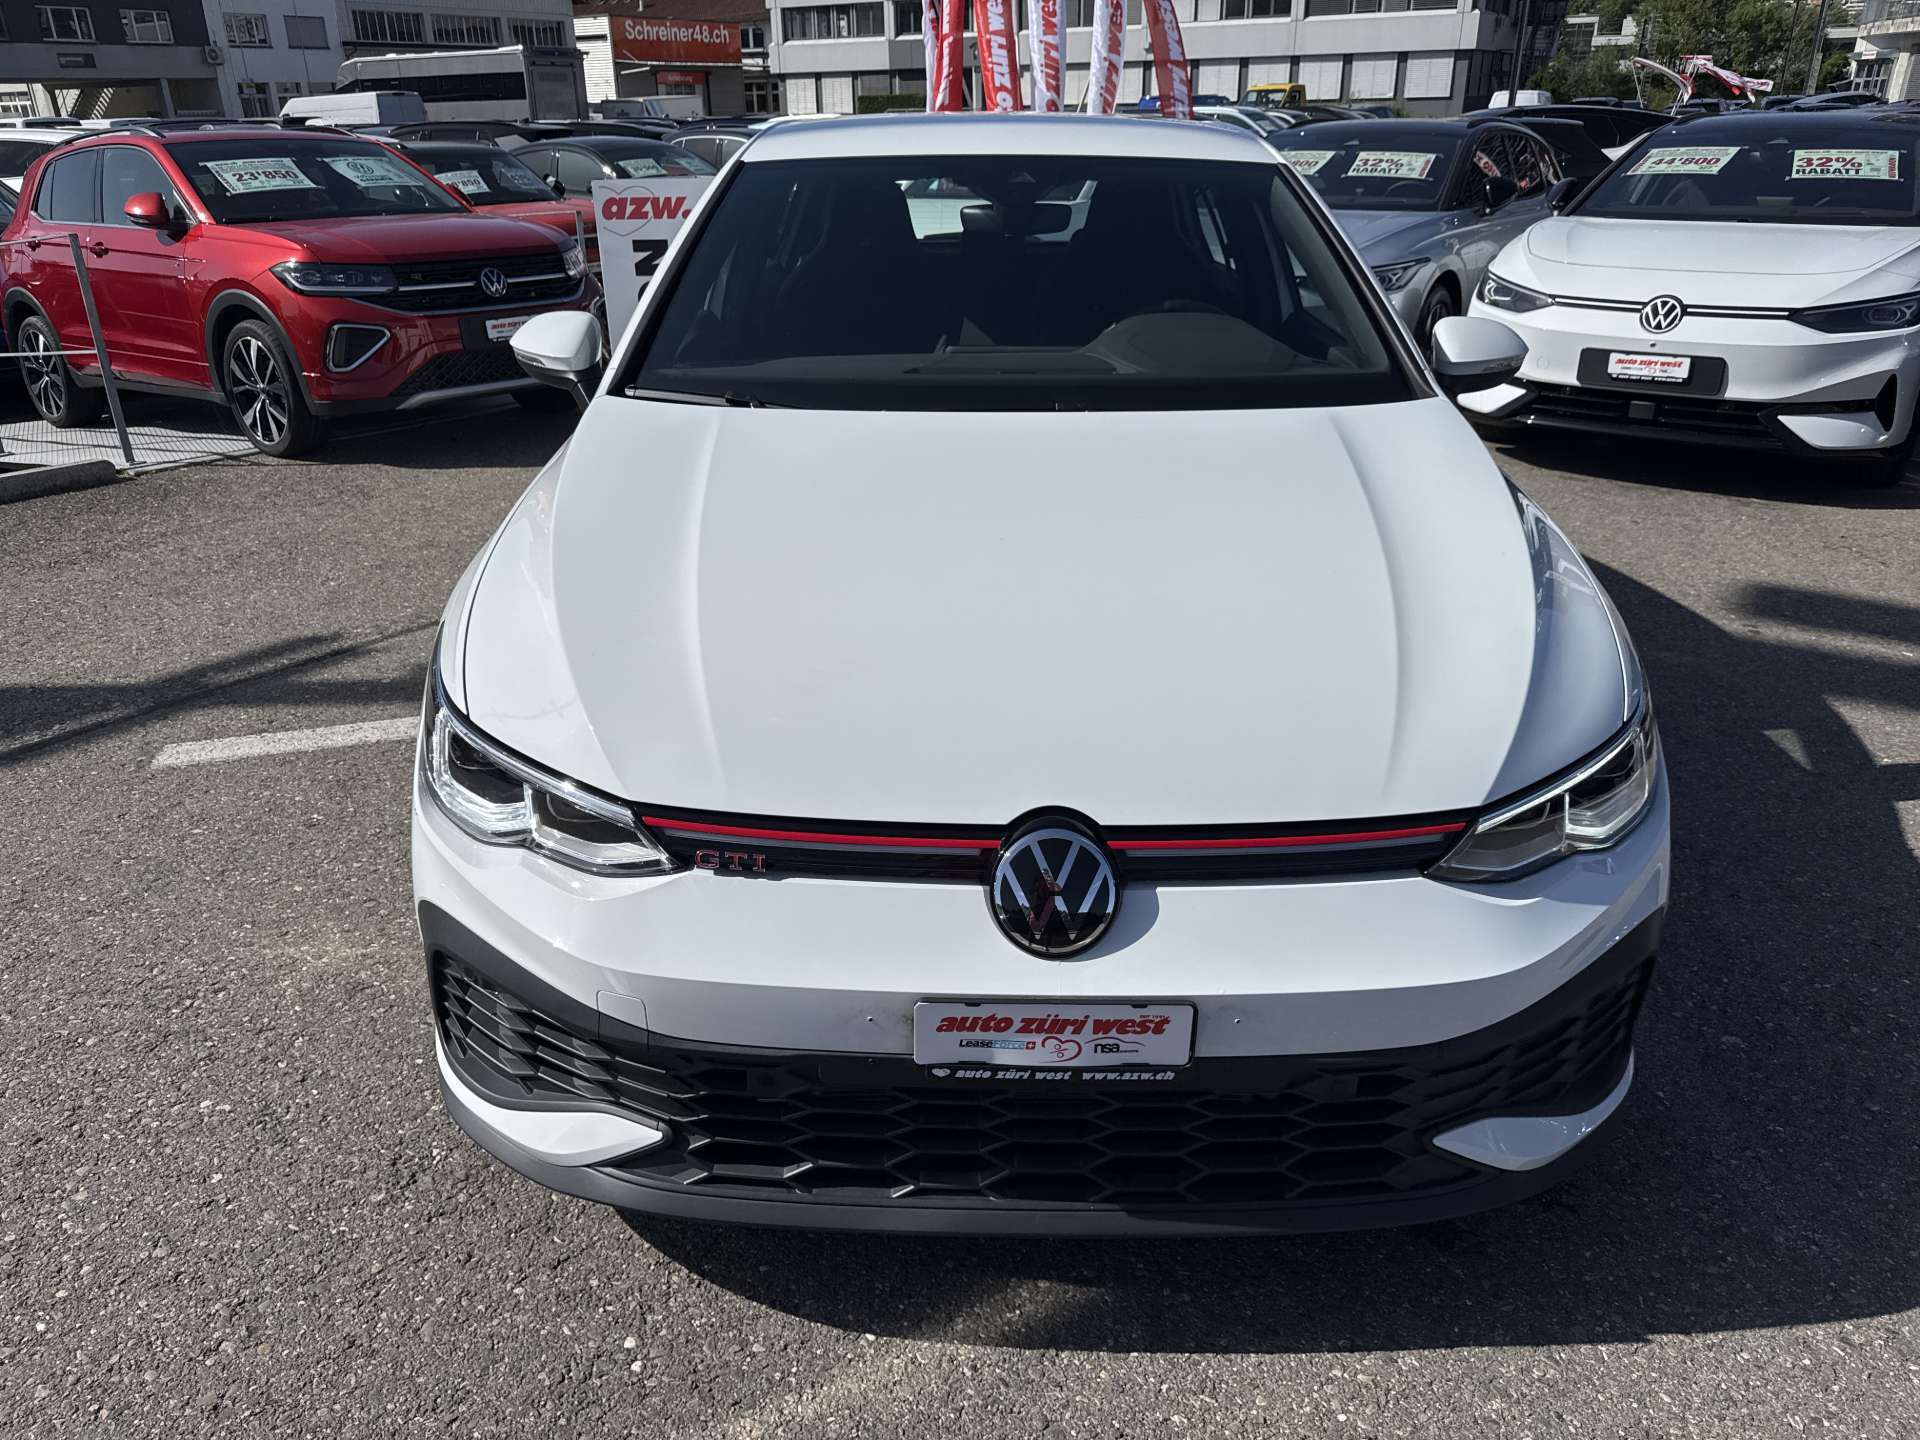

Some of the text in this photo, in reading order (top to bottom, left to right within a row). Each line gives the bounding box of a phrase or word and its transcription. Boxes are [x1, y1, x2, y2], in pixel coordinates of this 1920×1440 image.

[987, 0, 1006, 31] we
[625, 20, 730, 44] Schreiner48.ch
[986, 34, 1012, 90] züri
[1039, 40, 1060, 98] züri
[1358, 158, 1404, 168] 32%
[1651, 157, 1721, 165] 44'800
[1797, 157, 1863, 168] 32%
[232, 170, 299, 182] 23'850
[1351, 167, 1400, 175] RABATT
[695, 849, 766, 872] GTI
[936, 1012, 1171, 1035] auto züri west
[1094, 1043, 1120, 1053] nsa
[955, 1069, 992, 1079] auto
[995, 1068, 1031, 1080] züri
[1035, 1070, 1072, 1080] west
